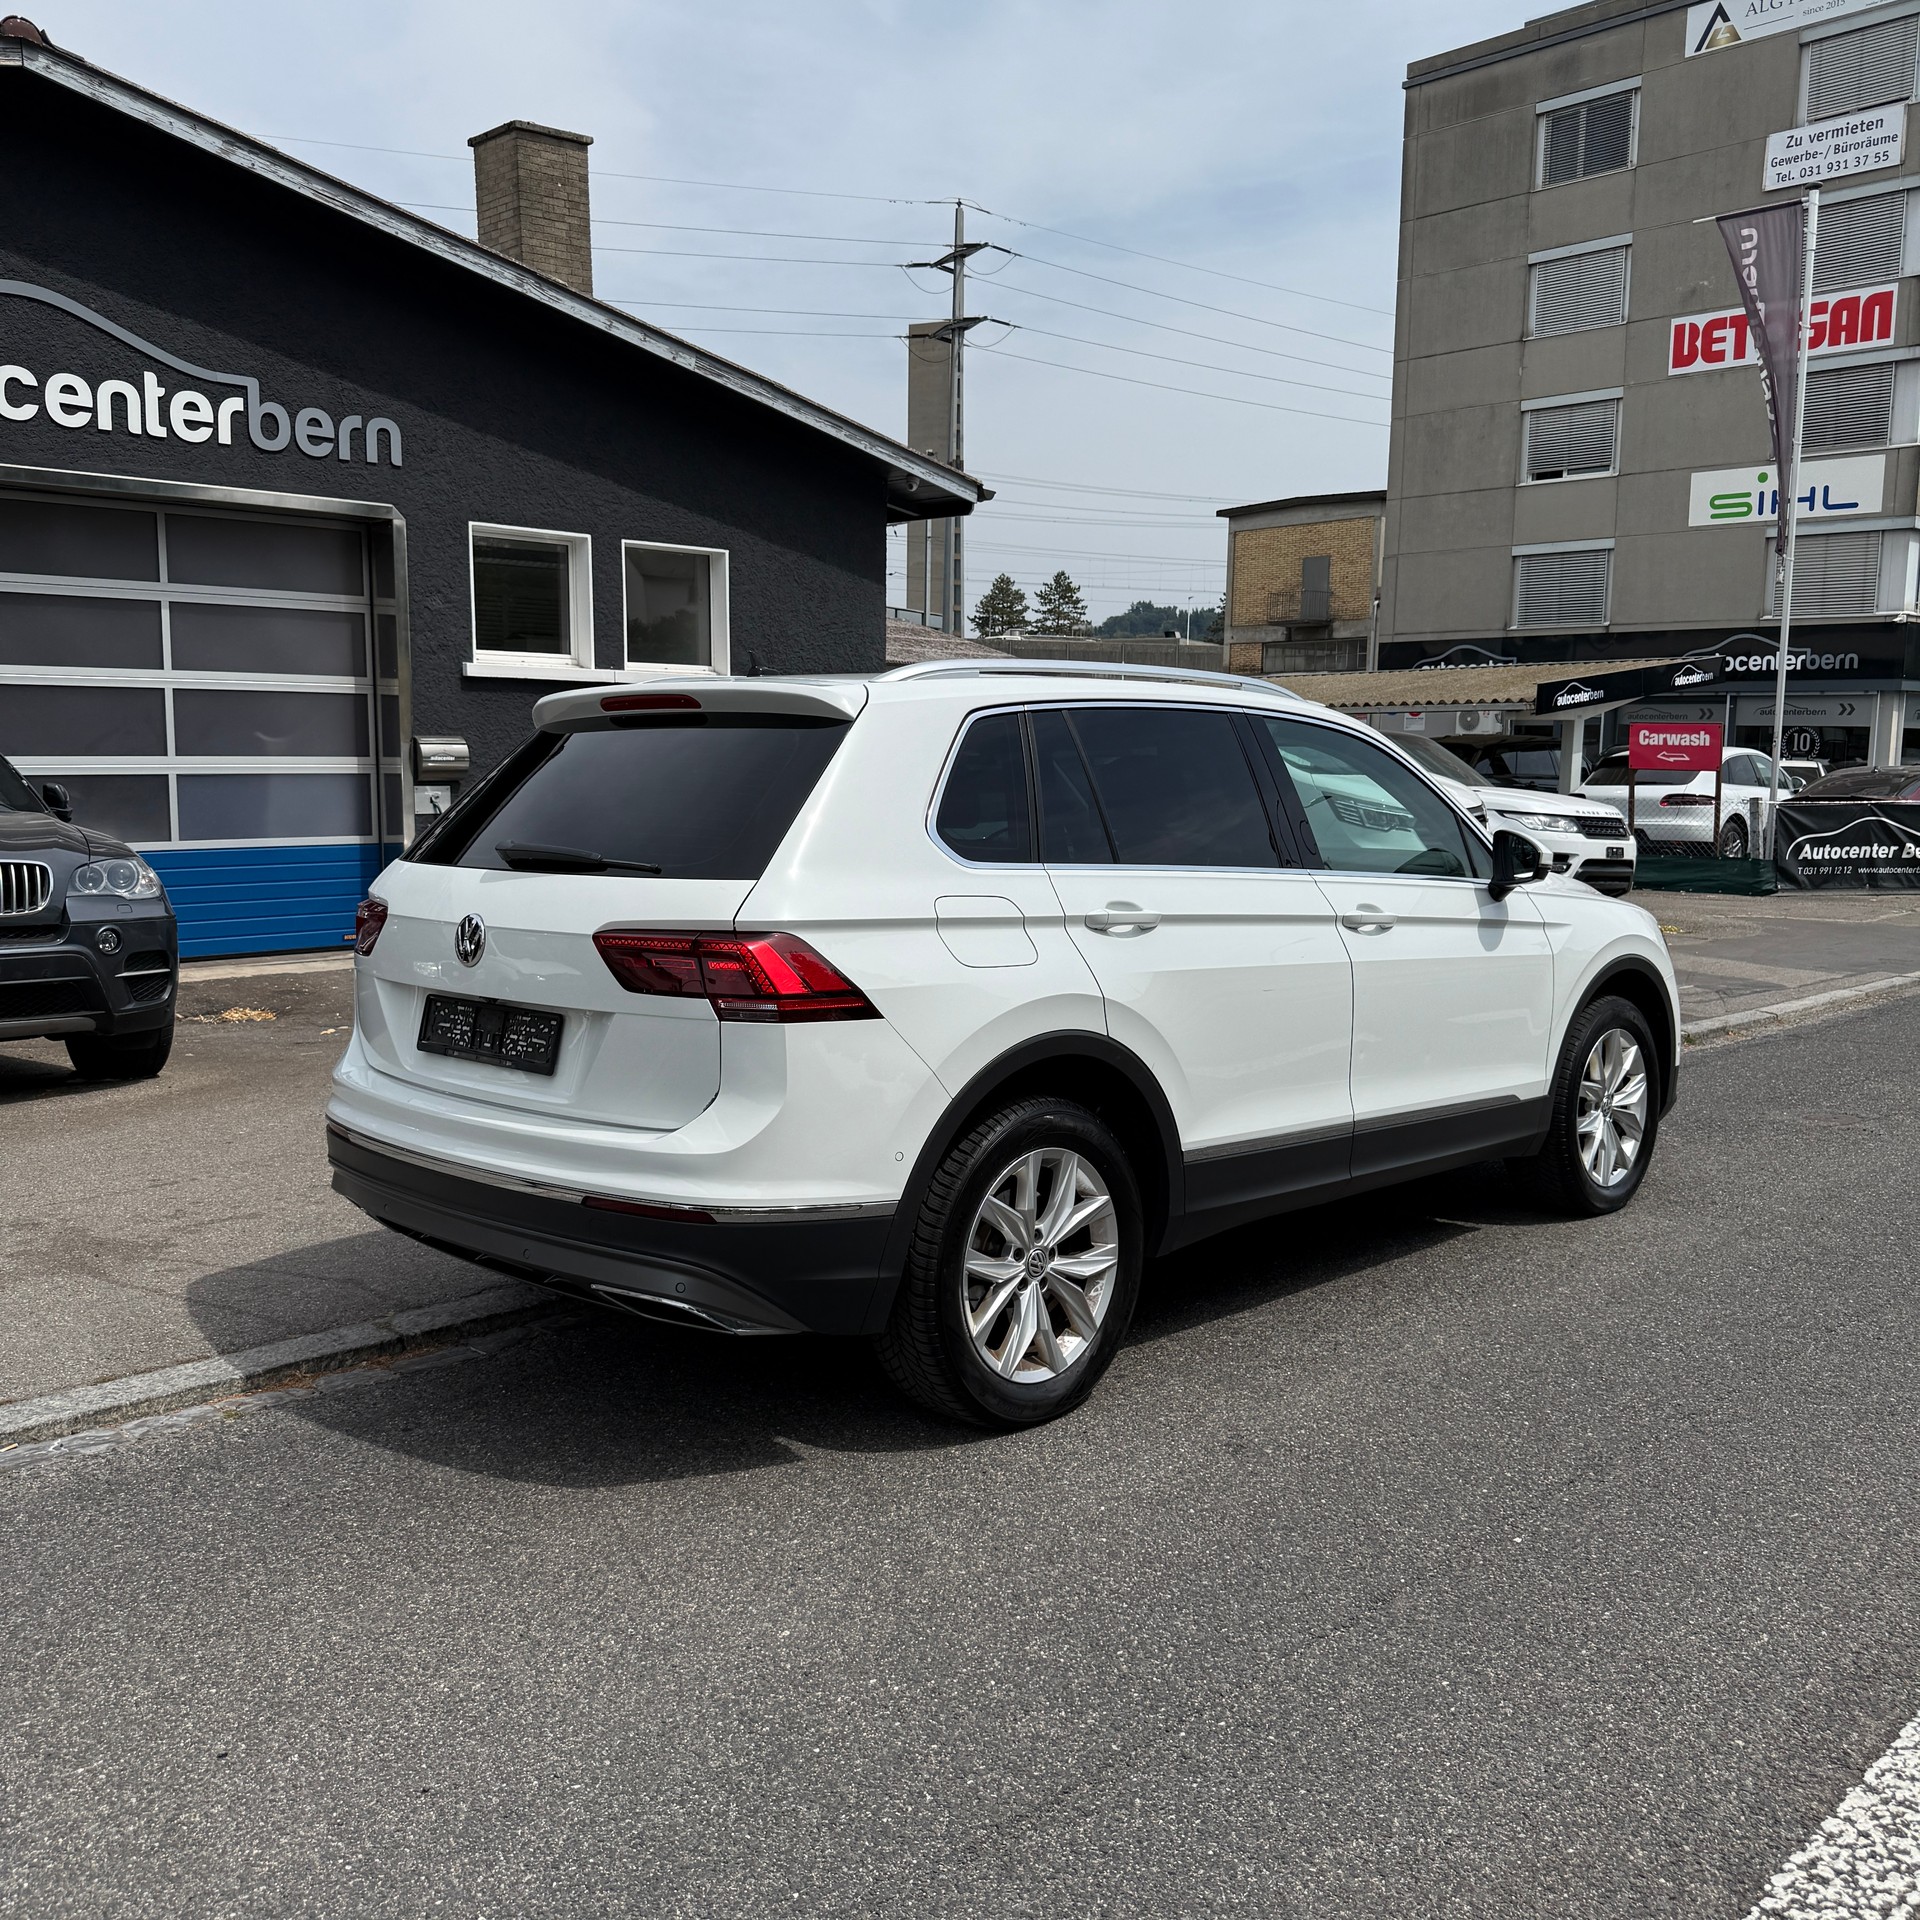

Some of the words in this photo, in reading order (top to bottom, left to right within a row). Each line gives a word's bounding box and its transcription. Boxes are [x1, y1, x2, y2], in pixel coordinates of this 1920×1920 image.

[1802, 4, 1824, 16] since
[1825, 0, 1846, 11] 2015
[1785, 135, 1803, 149] Zu
[1808, 118, 1884, 144] vermieten
[1775, 170, 1795, 183] Tel.
[1799, 165, 1821, 179] 031
[1826, 159, 1849, 173] 931
[1853, 155, 1869, 168] 37
[1874, 150, 1890, 164] 55
[1671, 290, 1895, 369] BETSAN
[1674, 671, 1714, 687] autocenterbern
[1556, 688, 1604, 707] autocenterbern
[1638, 729, 1711, 747] Carwash
[1792, 732, 1811, 752] 10
[1797, 843, 1899, 860] Autocenter
[1803, 867, 1817, 875] 031
[1819, 866, 1832, 875] 991
[1834, 866, 1842, 875] 12
[1843, 866, 1853, 874] 12
